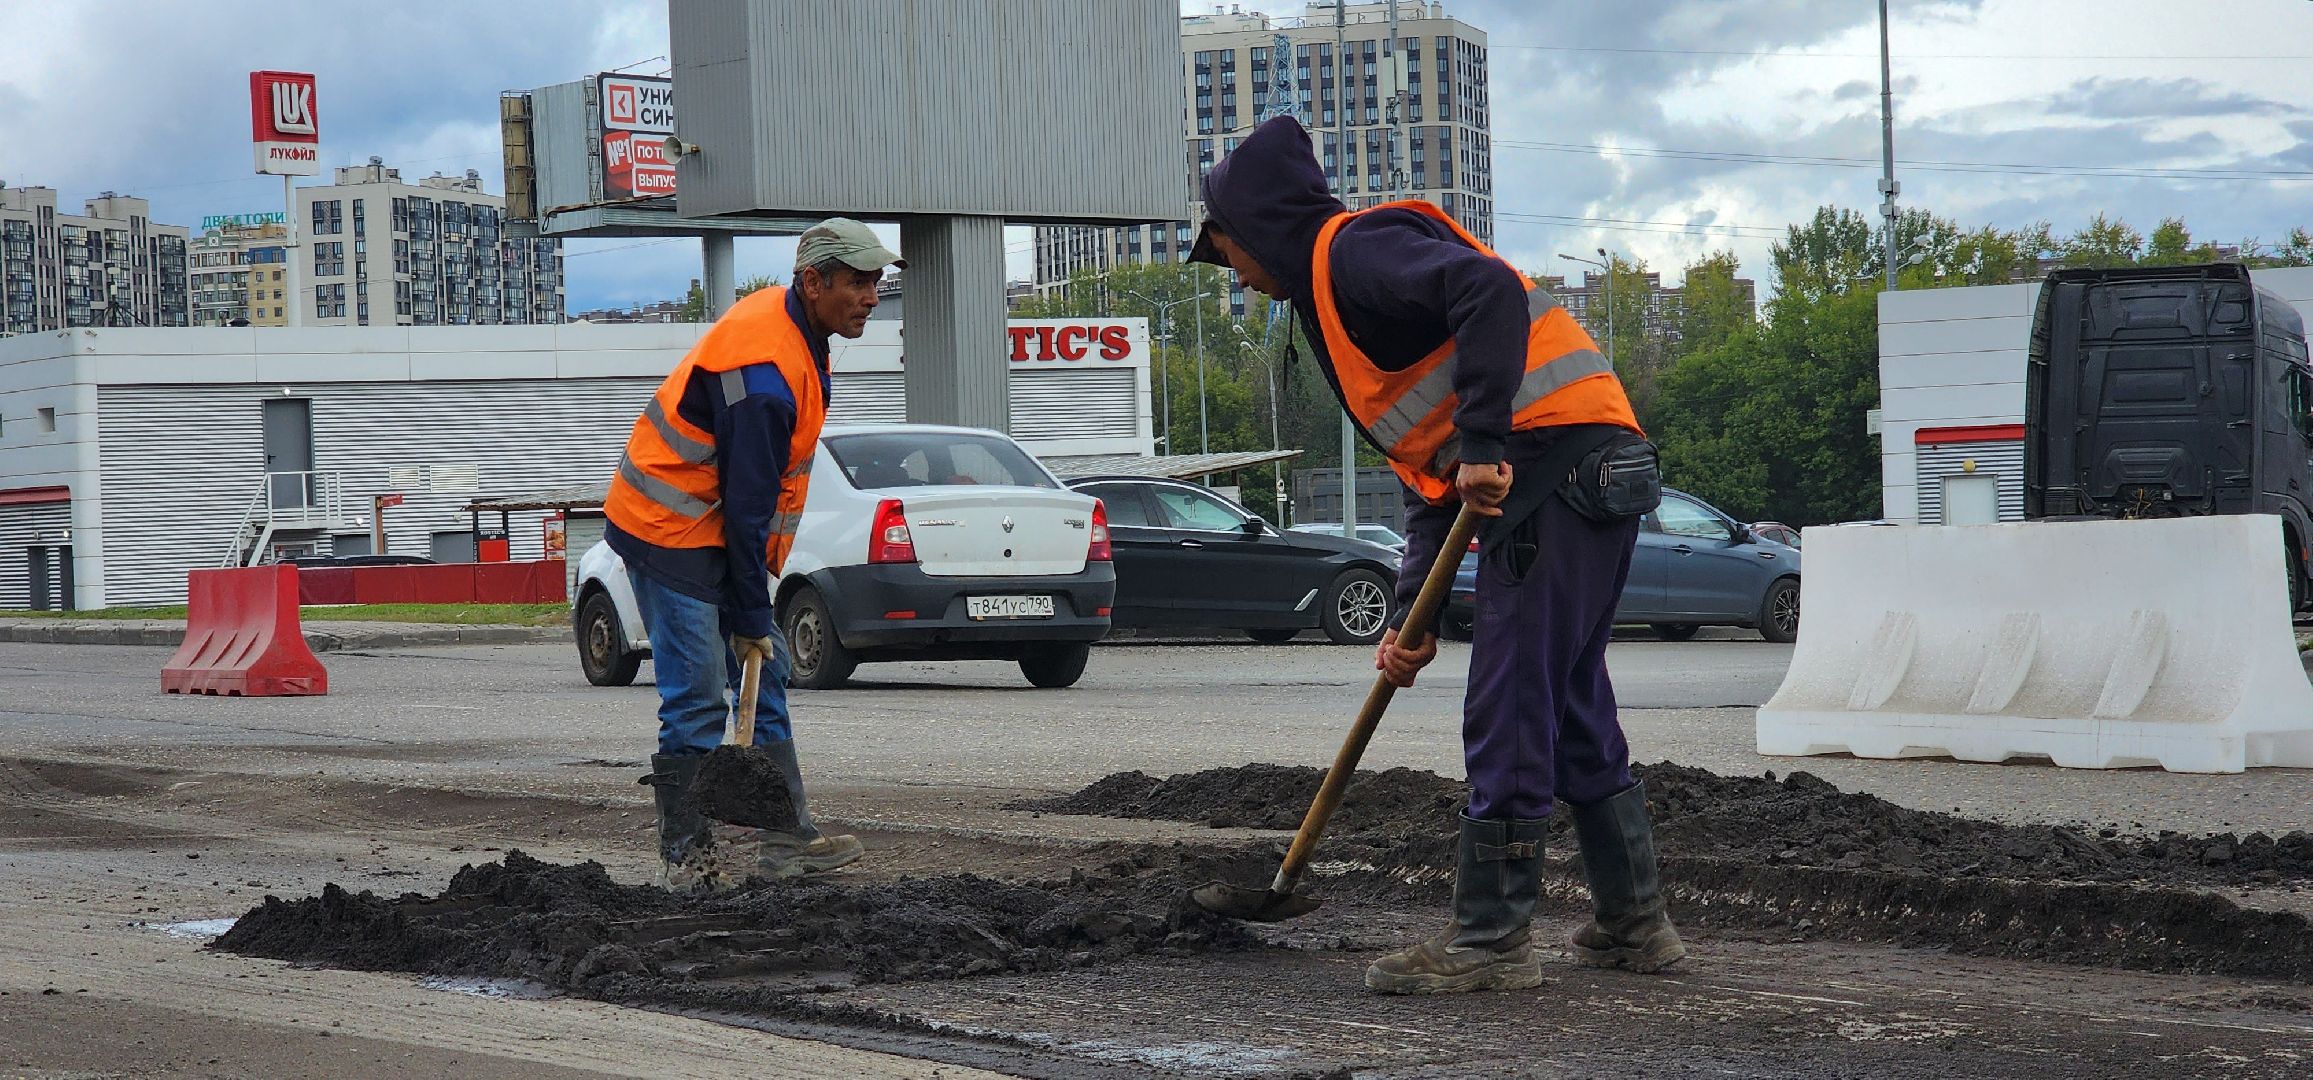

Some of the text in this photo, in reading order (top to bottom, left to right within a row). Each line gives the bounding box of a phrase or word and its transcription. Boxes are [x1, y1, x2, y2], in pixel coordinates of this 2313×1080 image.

[270, 147, 316, 161] ЛУКОЙЛ
[637, 145, 653, 158] ПО
[1008, 325, 1131, 362] TIC'S
